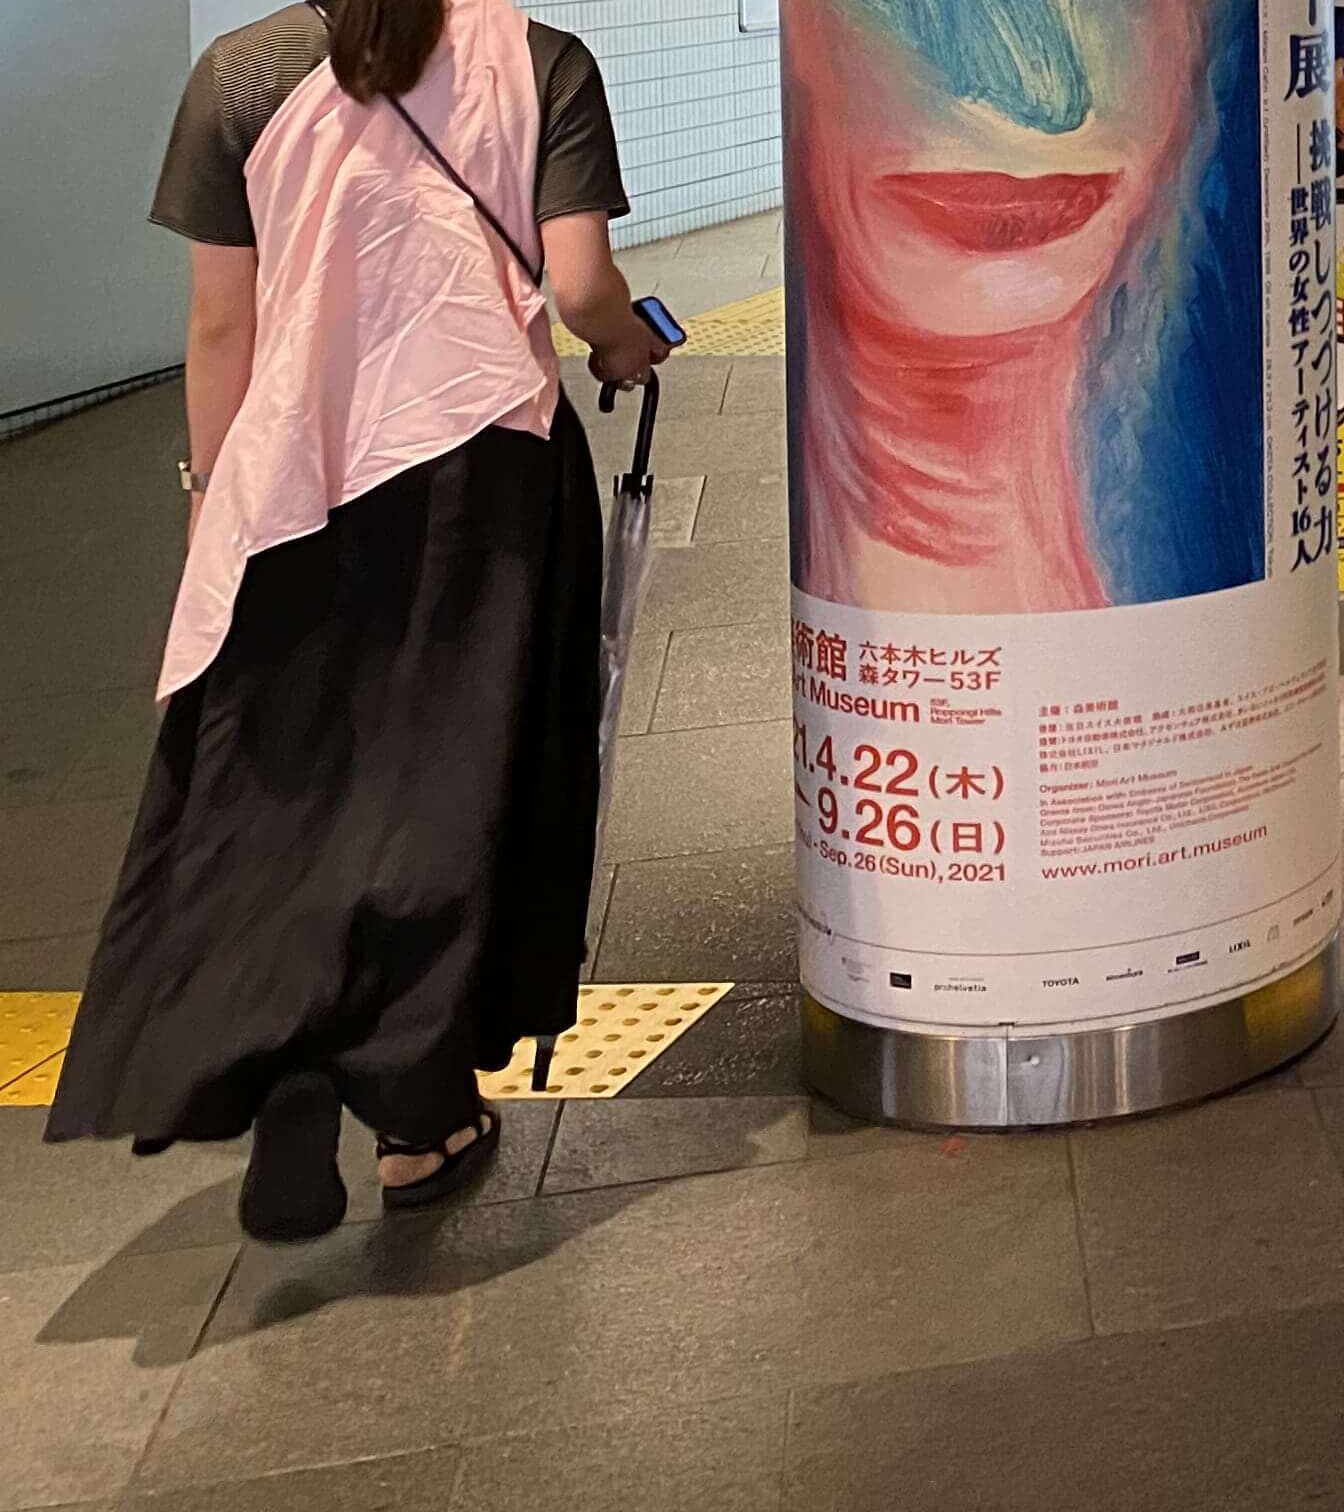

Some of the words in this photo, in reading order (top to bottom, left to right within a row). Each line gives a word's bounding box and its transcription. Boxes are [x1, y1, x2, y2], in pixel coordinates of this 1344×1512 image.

[859, 640, 1002, 668] 六本木ヒルズ
[858, 664, 1002, 691] 森タワー53F
[810, 676, 920, 723] Museum
[1041, 825, 1268, 879] www.mori.art.museum
[947, 863, 1005, 882] 2021
[1042, 977, 1080, 988] TOYOTA
